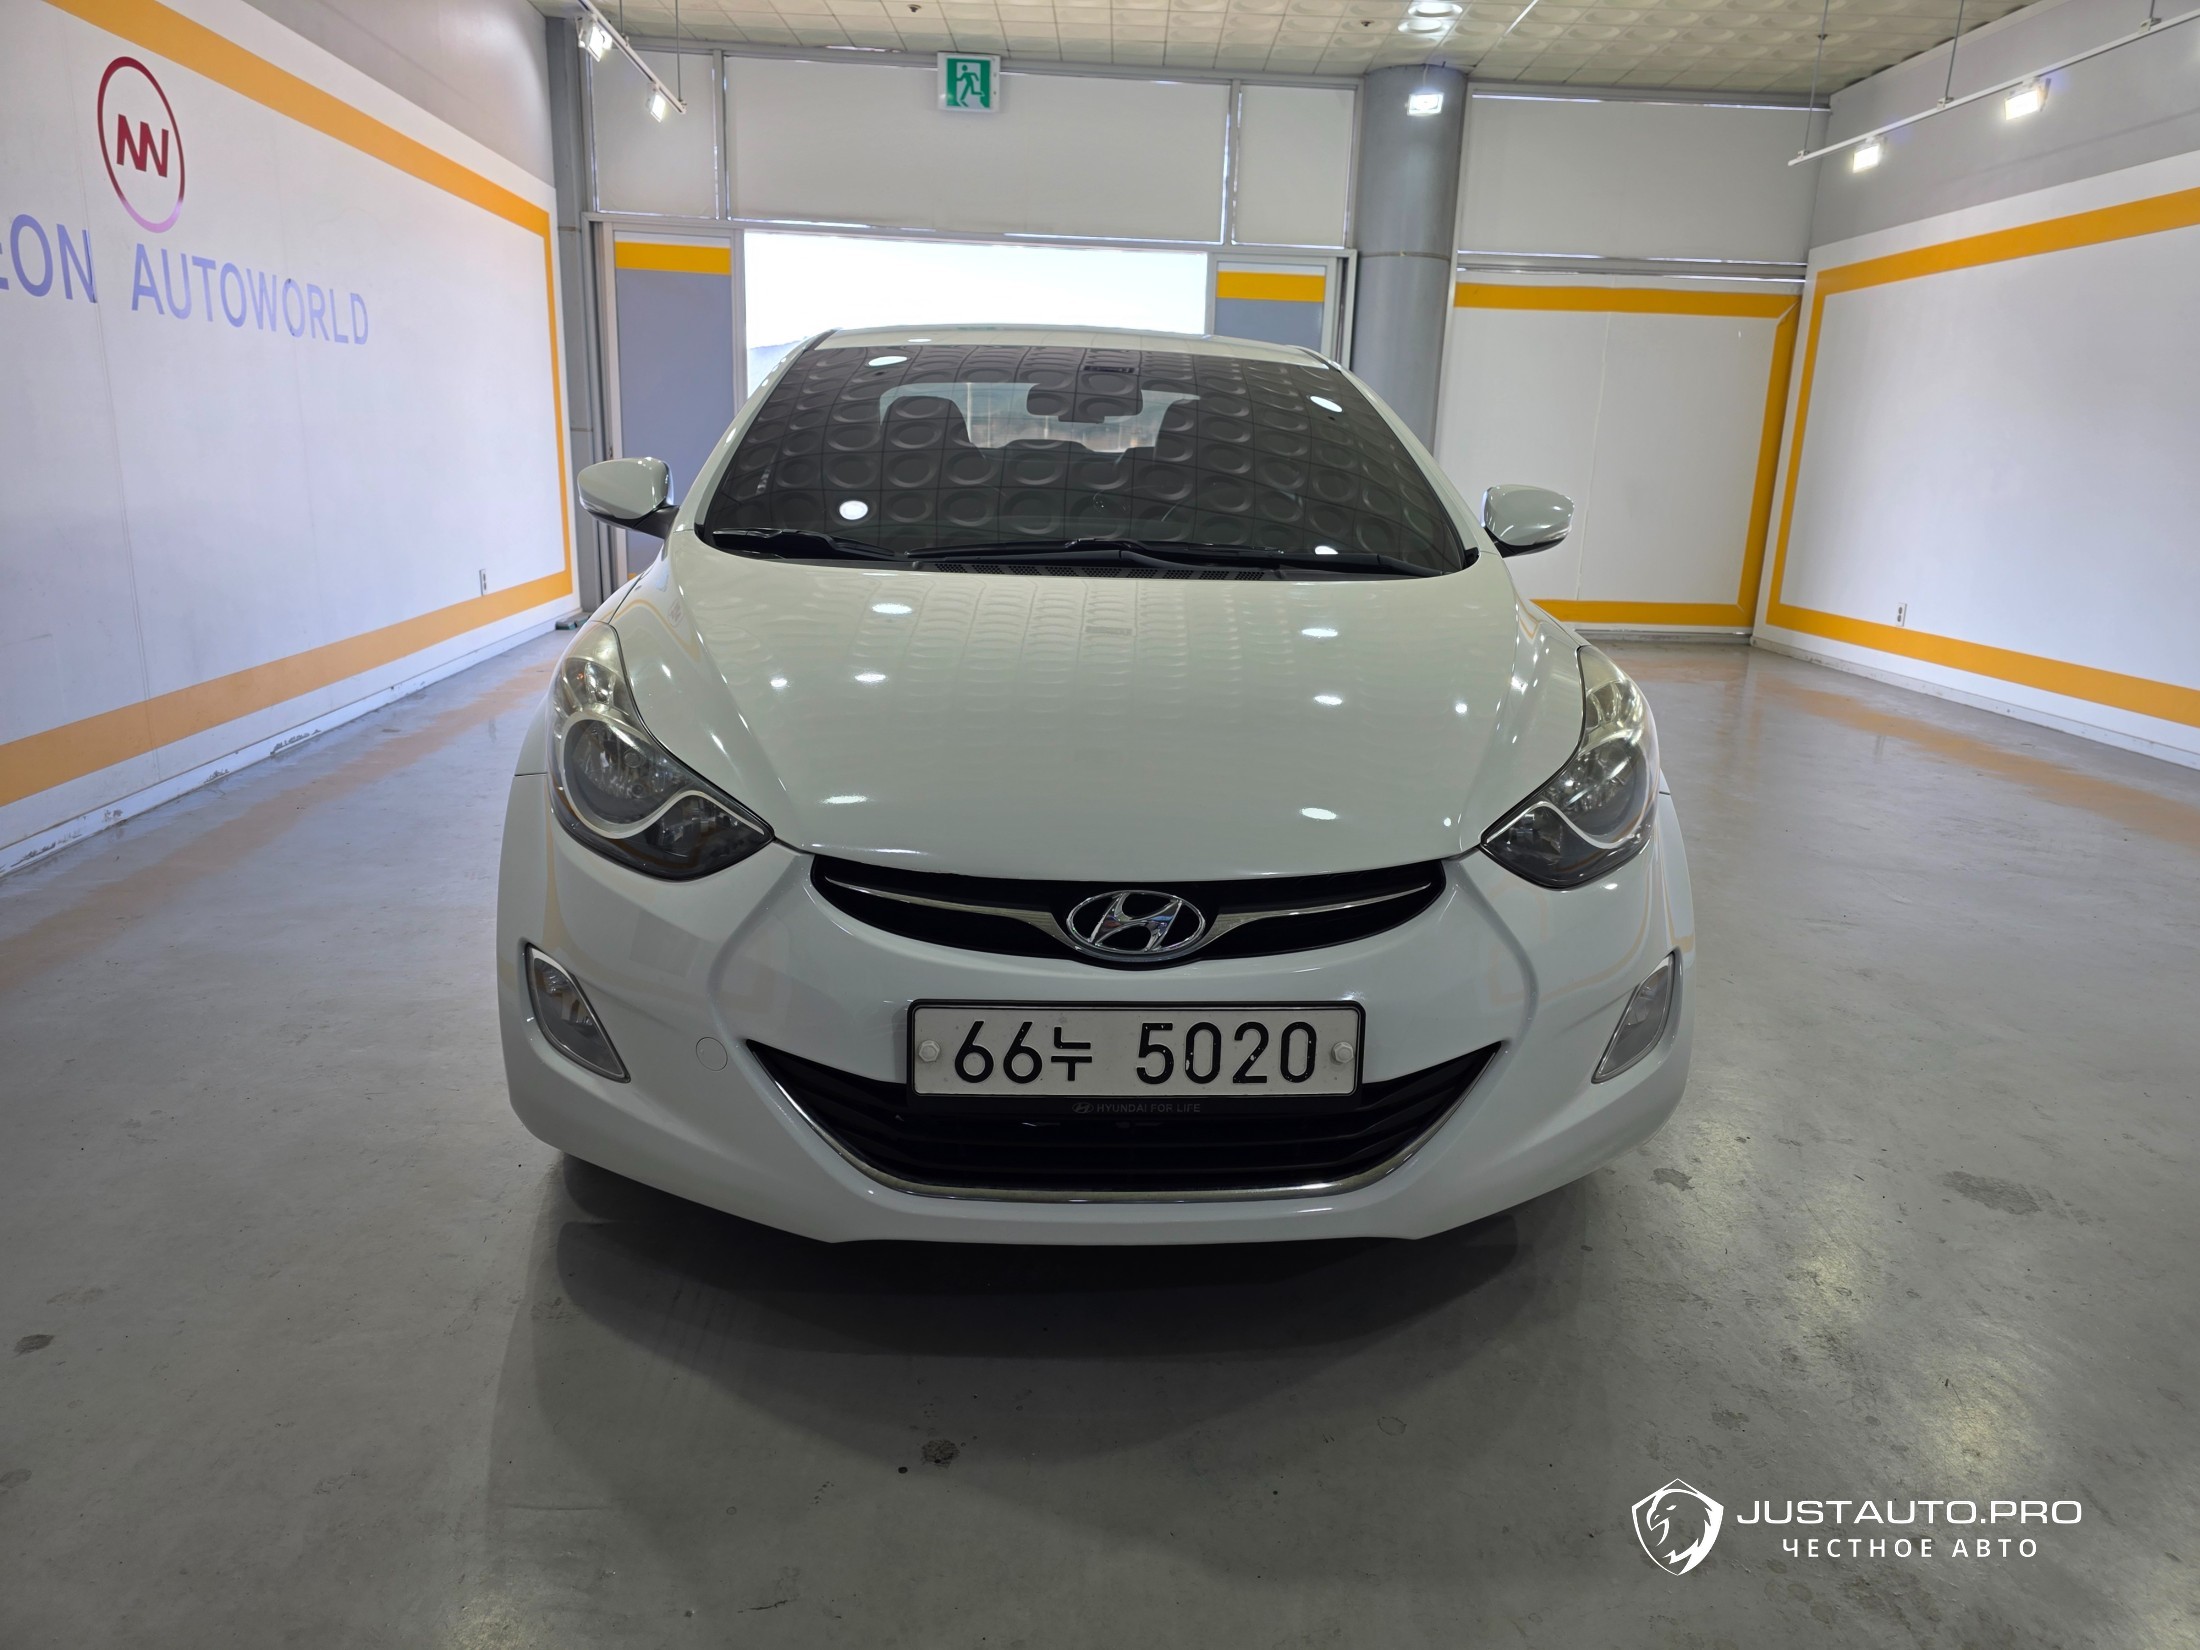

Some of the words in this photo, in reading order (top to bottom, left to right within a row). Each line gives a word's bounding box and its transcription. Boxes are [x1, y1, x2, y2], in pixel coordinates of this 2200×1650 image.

[131, 243, 370, 346] AUTOWORLD
[954, 1020, 1093, 1085] 66누
[1135, 1021, 1317, 1085] 5020
[1096, 1103, 1147, 1113] HYUNDAI
[1150, 1103, 1173, 1113] FOR
[1177, 1103, 1201, 1113] LIFE
